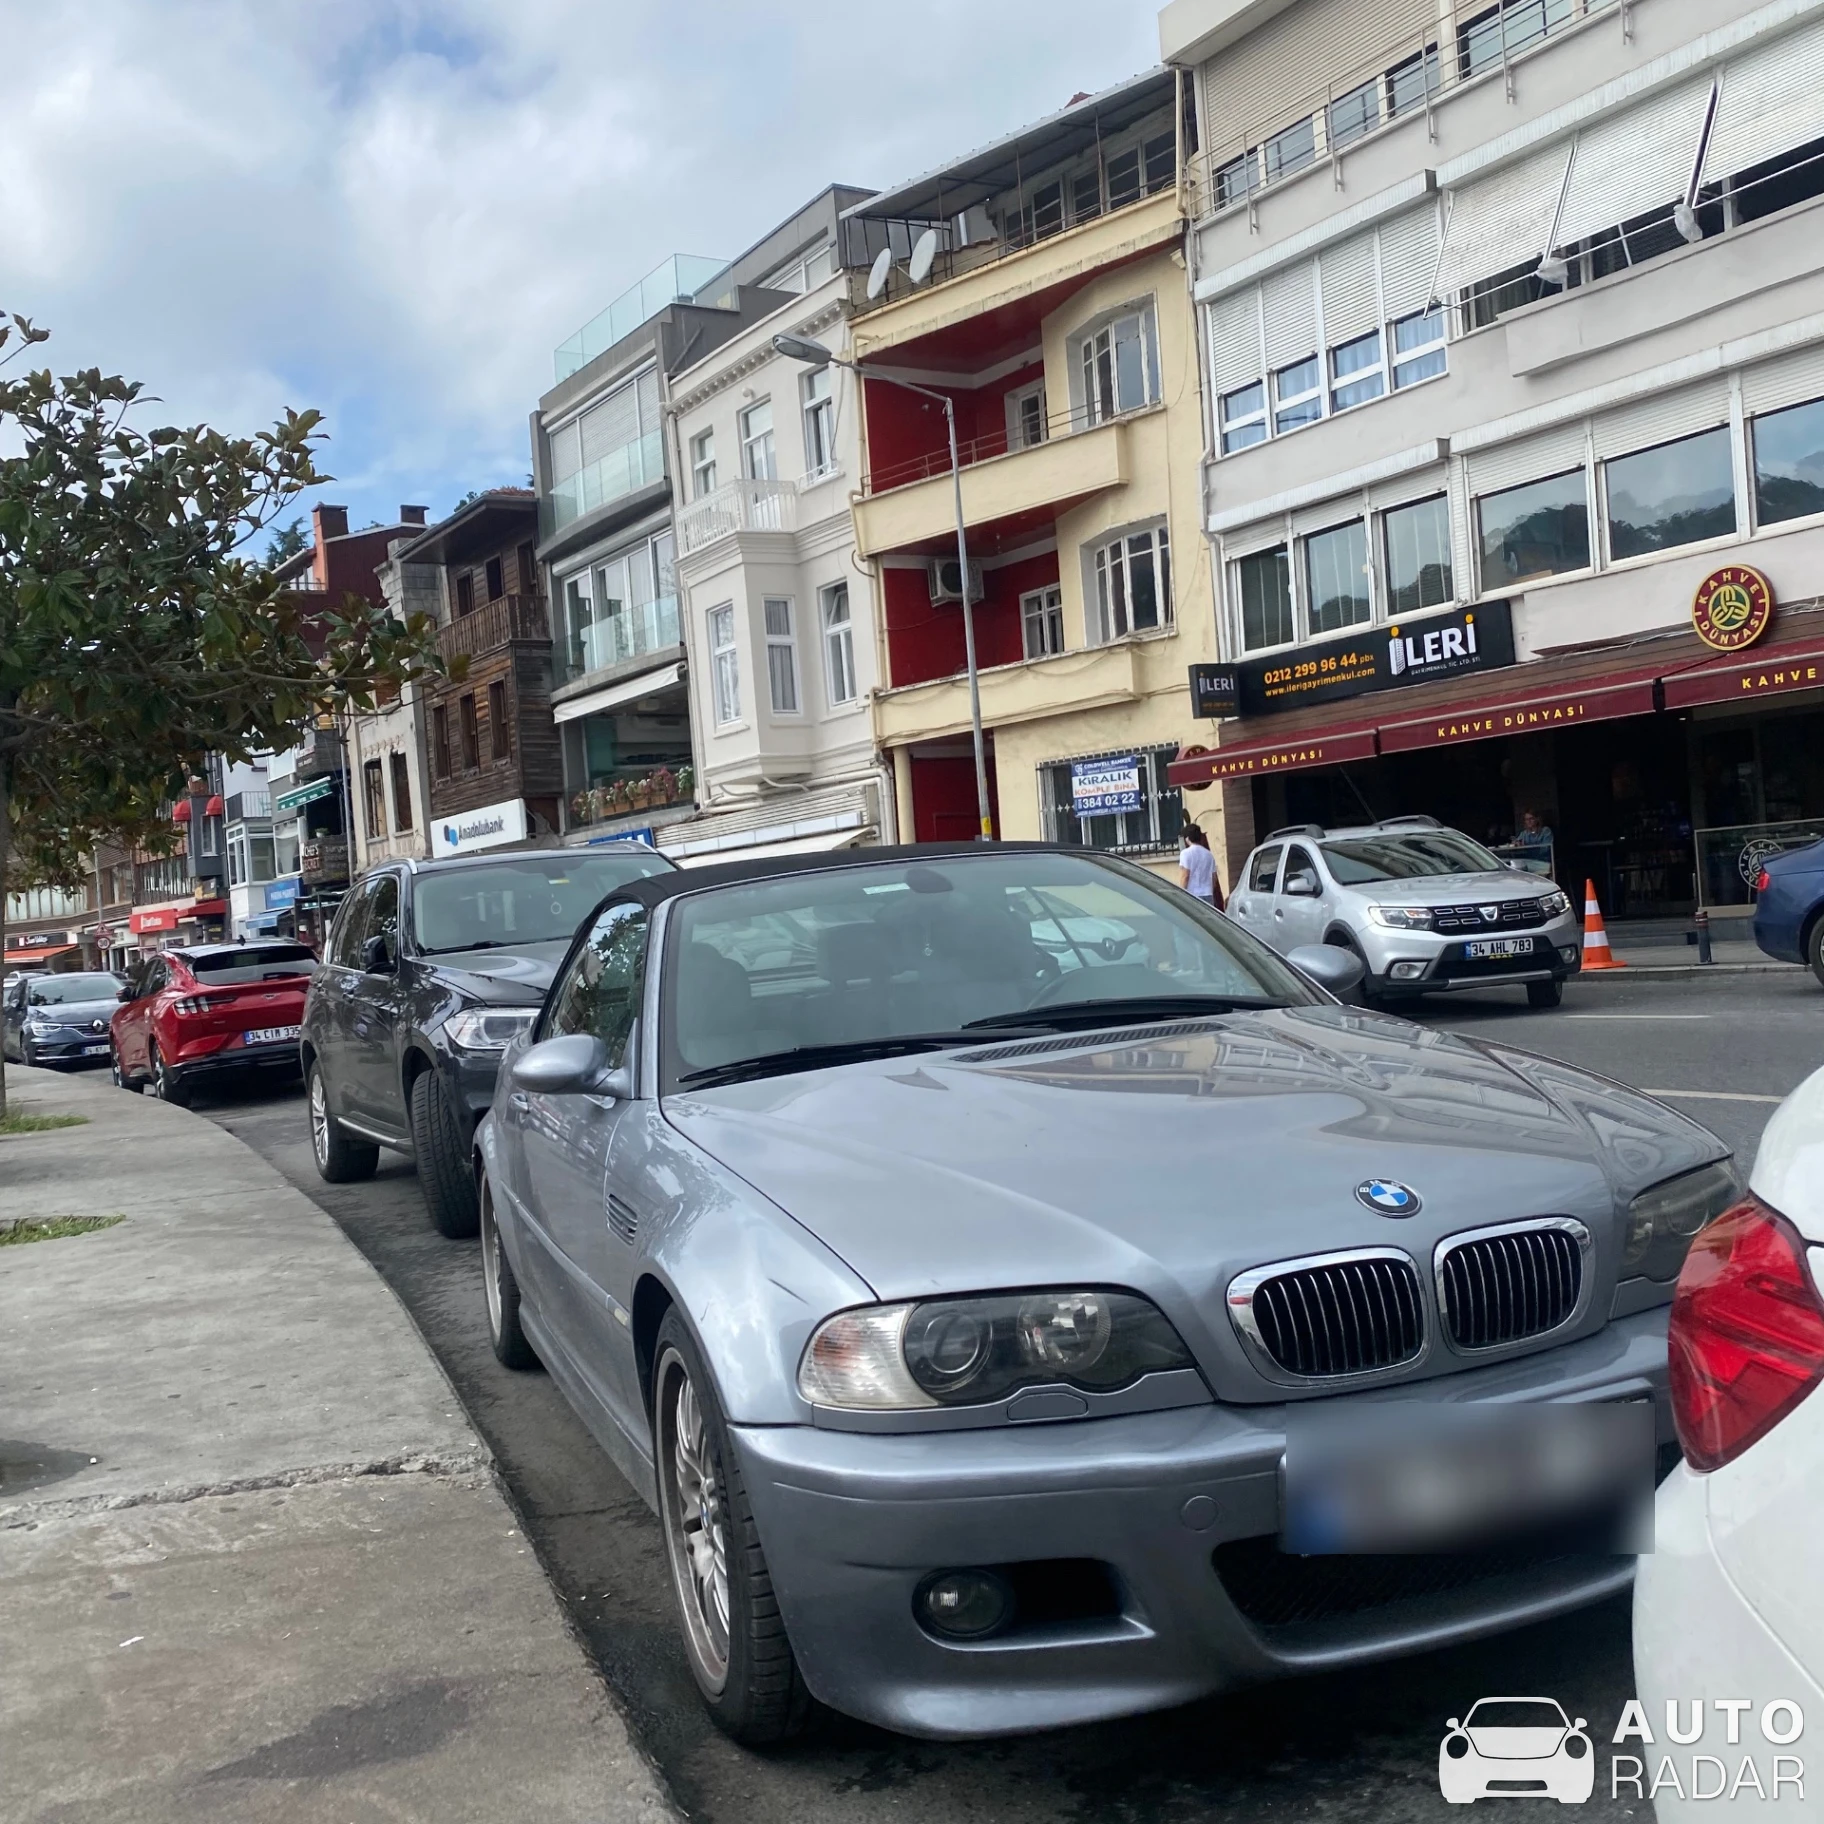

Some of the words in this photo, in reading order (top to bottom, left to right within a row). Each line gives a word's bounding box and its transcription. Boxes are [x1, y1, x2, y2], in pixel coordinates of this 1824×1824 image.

[1698, 571, 1760, 604] KAHVE
[1700, 611, 1763, 644] DÜNYASI
[1264, 668, 1292, 684] 0212
[1294, 662, 1317, 678] 299
[1320, 657, 1337, 672] 96
[1340, 652, 1358, 667] 44
[1360, 654, 1375, 664] pbx
[1742, 668, 1816, 689] KAHVE
[1265, 667, 1376, 697] www.ilerigayrimenkul.com
[1438, 720, 1493, 737] KAHVE
[1504, 705, 1584, 727] DÜNYASI
[1211, 760, 1254, 774] KAHVE
[1262, 749, 1323, 767] DÜNYASI
[1075, 785, 1111, 796] KOMPLE
[1082, 796, 1102, 809] 384
[1105, 795, 1119, 806] 02
[1121, 792, 1136, 804] 22
[459, 815, 505, 841] Anadolubank
[1472, 943, 1485, 956] 34
[1490, 941, 1509, 954] AHL
[1512, 939, 1532, 952] 783
[249, 1031, 261, 1041] 34
[283, 1026, 300, 1037] 335
